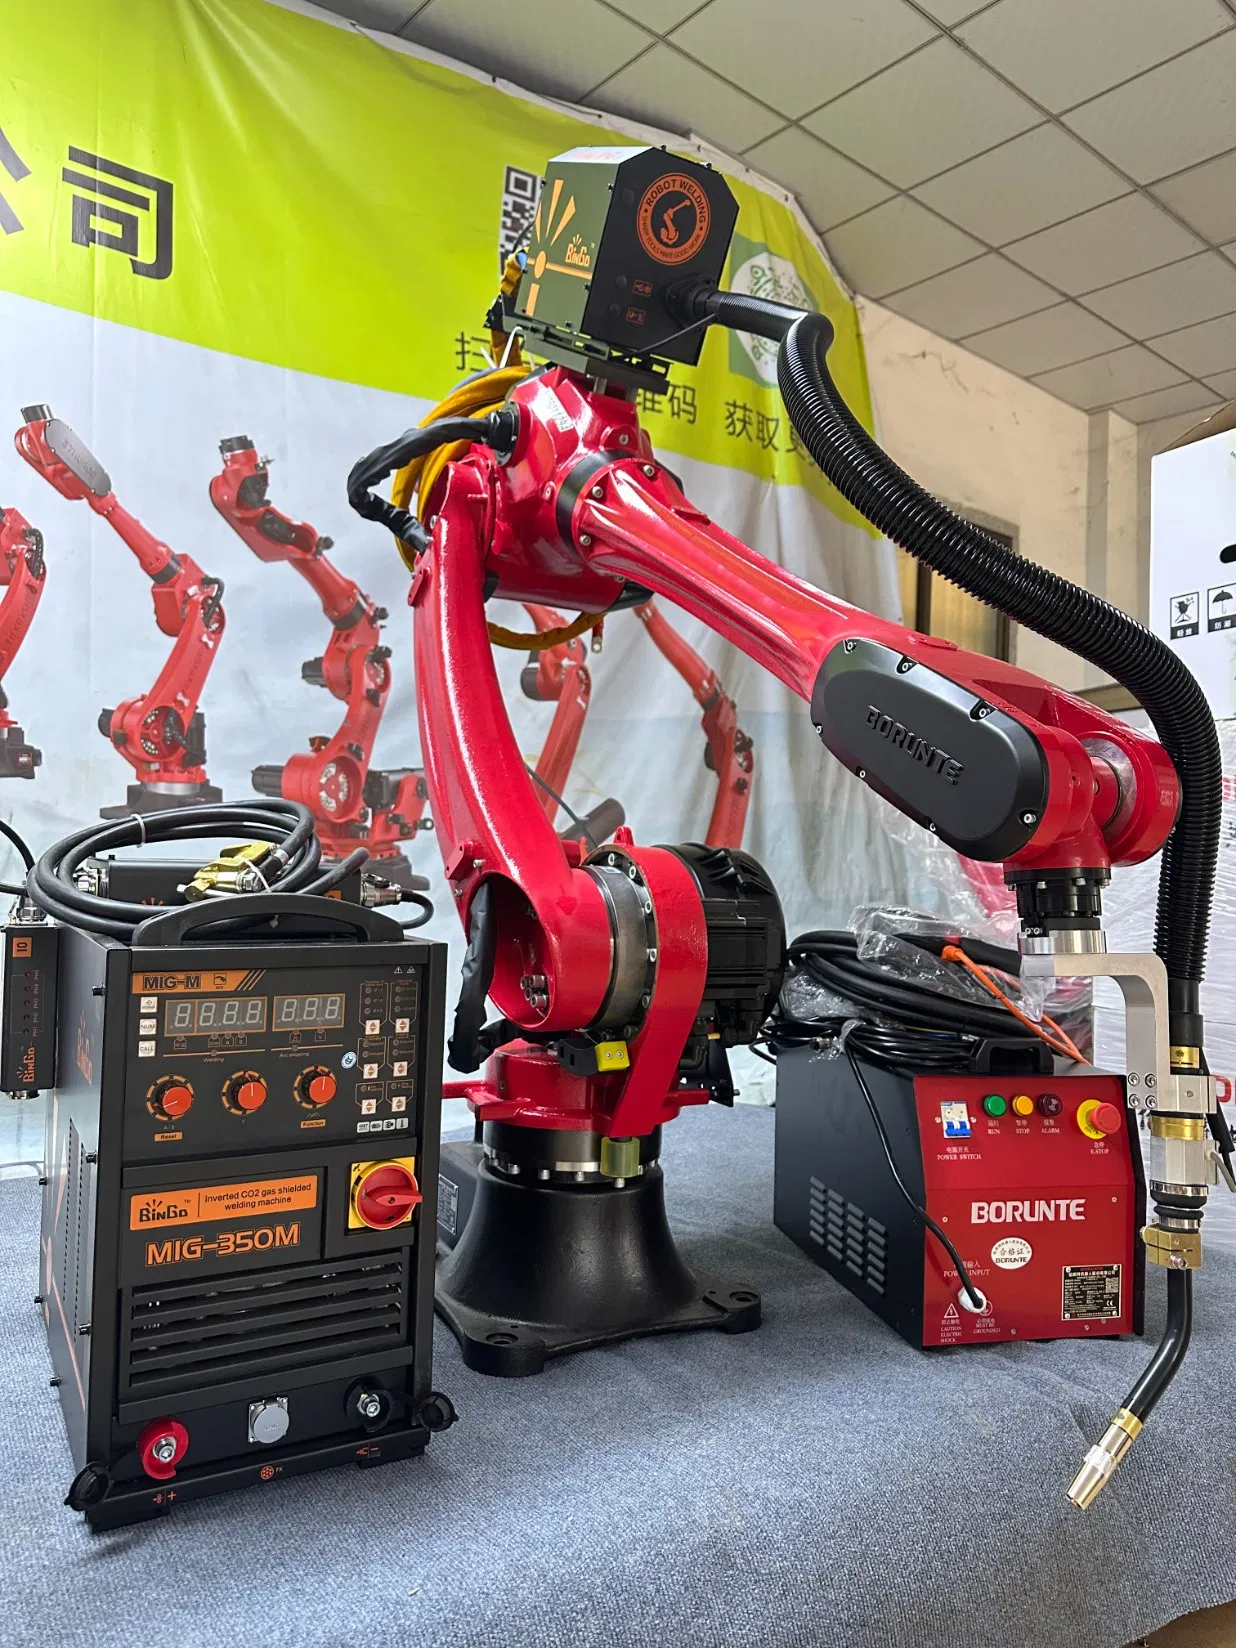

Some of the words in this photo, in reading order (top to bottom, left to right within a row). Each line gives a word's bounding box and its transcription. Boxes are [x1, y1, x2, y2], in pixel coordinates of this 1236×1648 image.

[645, 179, 678, 207] ROBOT
[679, 180, 706, 223] WELDING
[866, 705, 964, 786] BORUNTE
[142, 974, 202, 991] MIG-M
[204, 1192, 239, 1203] Inverted
[241, 1189, 259, 1198] CO2
[261, 1188, 276, 1198] gas
[278, 1184, 312, 1195] shielded
[224, 1199, 256, 1211] welding
[258, 1196, 292, 1207] machine
[970, 1199, 1086, 1224] BORUNTE
[146, 1222, 300, 1267] MIG-350M
[995, 1256, 1028, 1264] BORUNTE
